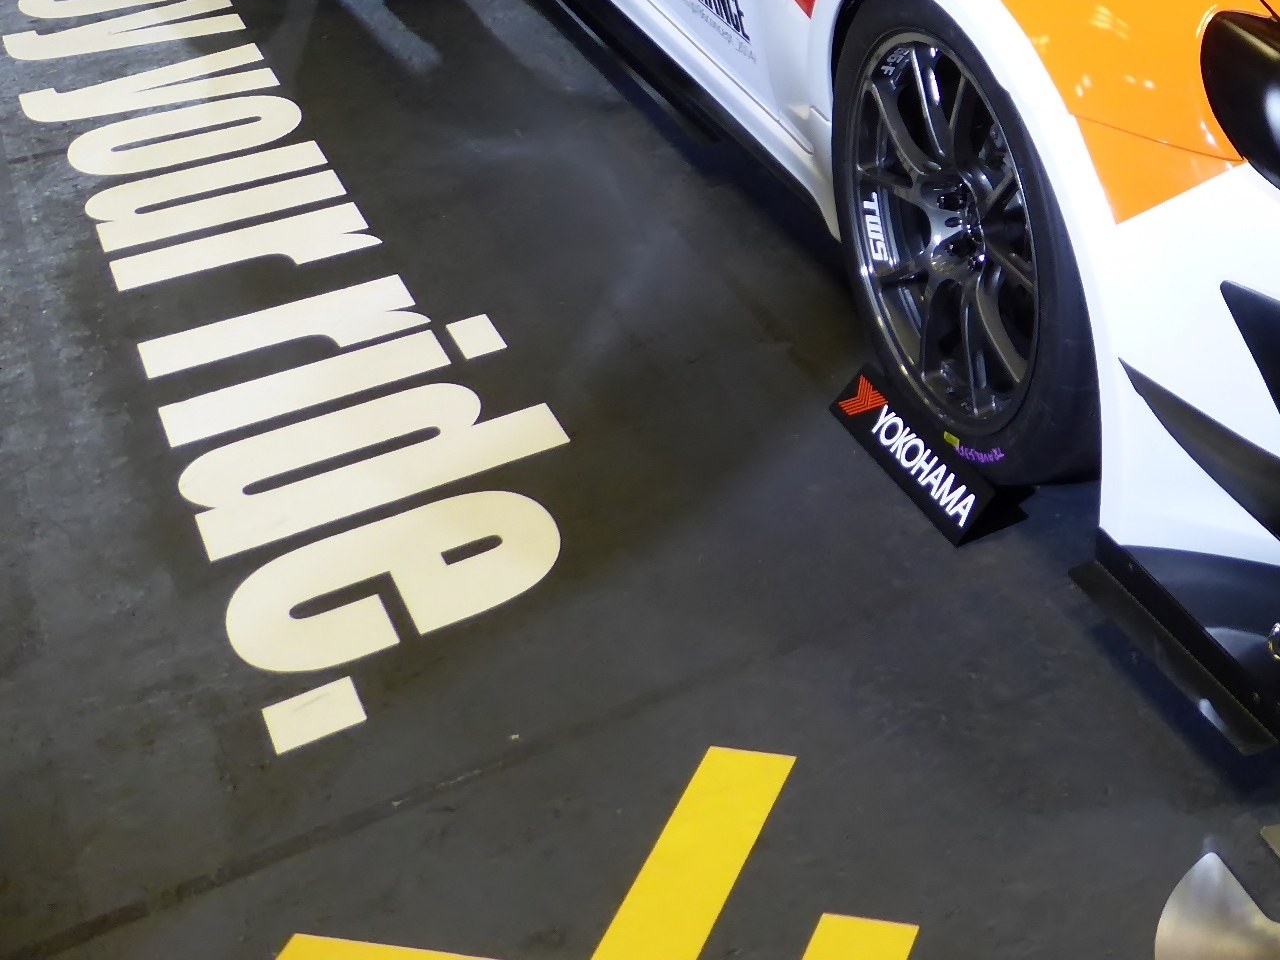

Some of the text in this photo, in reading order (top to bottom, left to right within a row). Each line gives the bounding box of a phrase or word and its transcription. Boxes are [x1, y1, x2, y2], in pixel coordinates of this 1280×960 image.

[19, 43, 382, 292] your
[862, 191, 888, 262] TWS
[137, 274, 570, 755] ride.
[871, 404, 976, 528] YOKOHAMA
